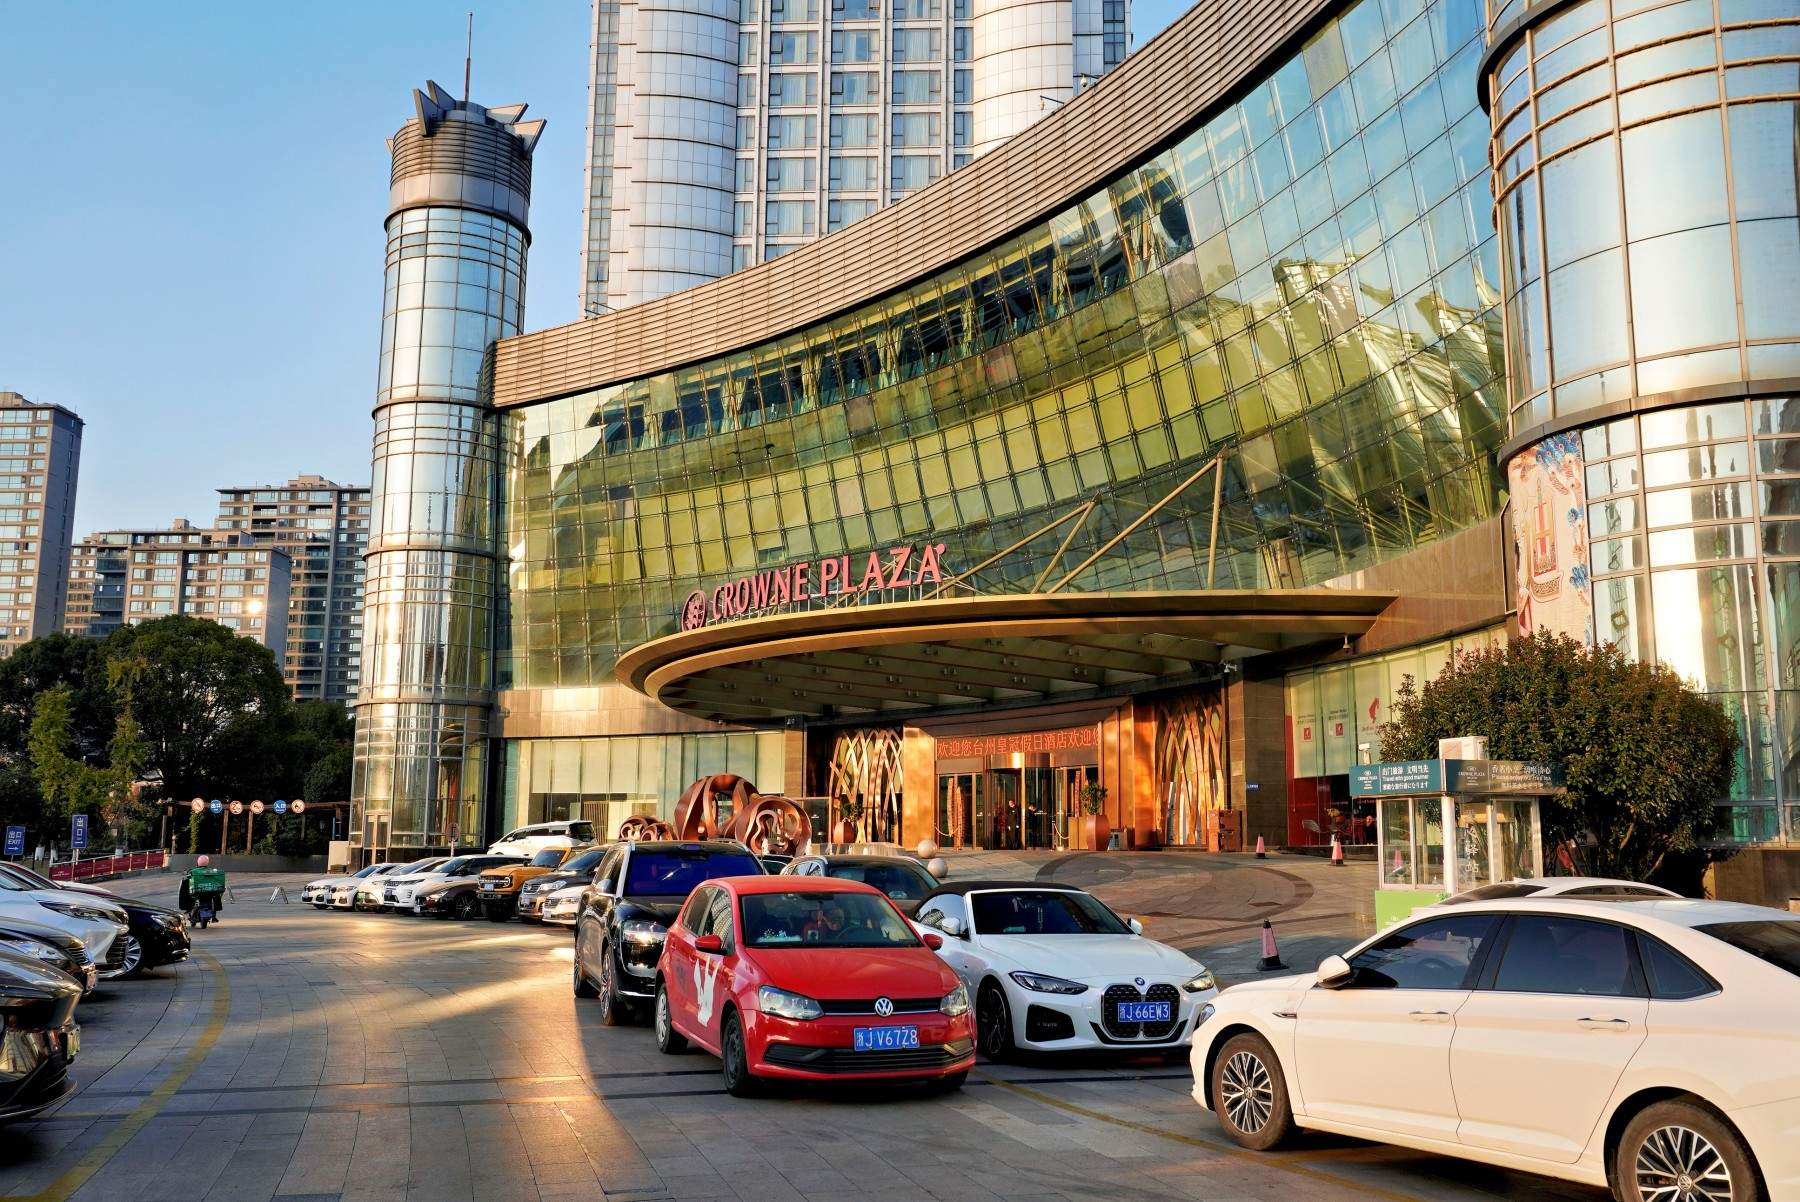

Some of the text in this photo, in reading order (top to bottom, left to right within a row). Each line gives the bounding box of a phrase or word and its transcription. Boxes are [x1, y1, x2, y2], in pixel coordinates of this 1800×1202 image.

[713, 544, 942, 620] CROWNE PLAZA
[8, 830, 22, 839] 出口
